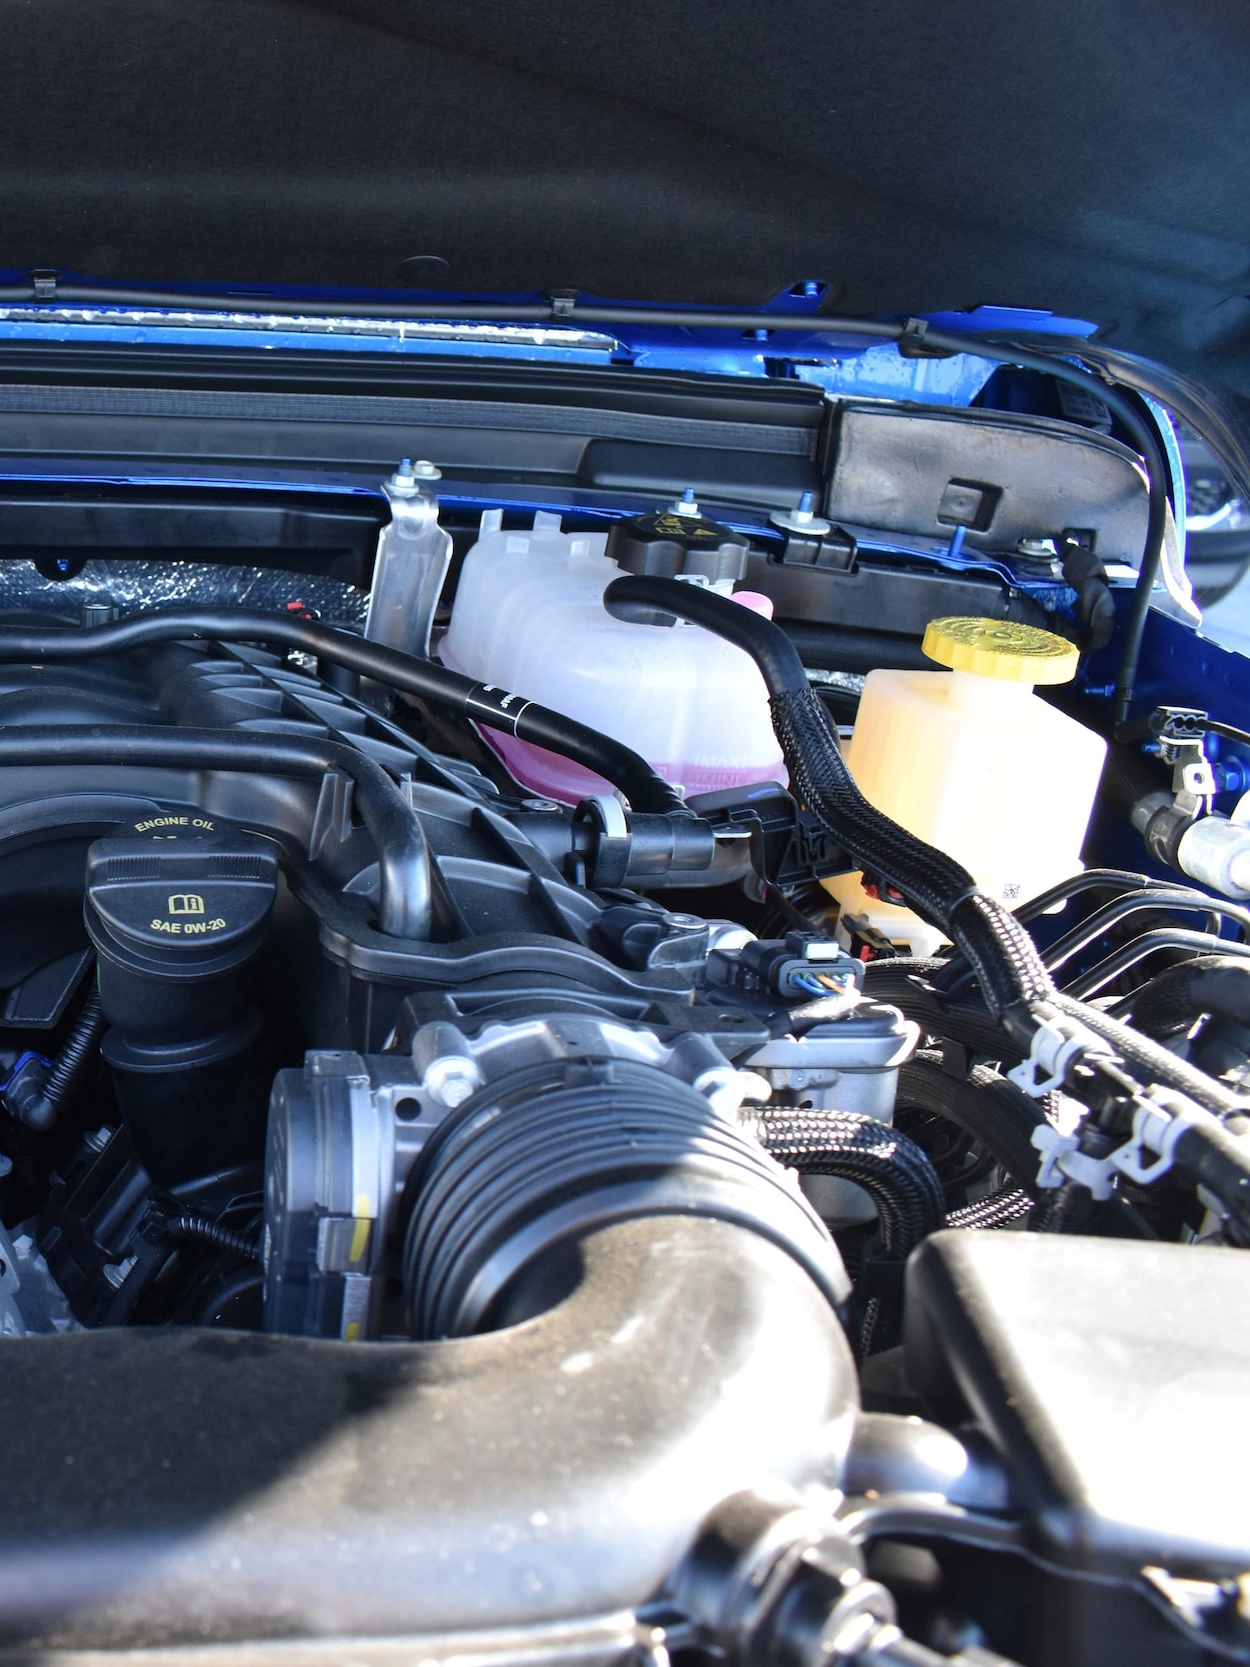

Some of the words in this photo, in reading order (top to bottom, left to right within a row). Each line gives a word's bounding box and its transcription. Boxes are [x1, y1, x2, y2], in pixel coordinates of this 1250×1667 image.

[134, 816, 189, 832] ENGINE
[192, 818, 215, 831] OIL
[150, 919, 181, 934] SAE
[184, 918, 226, 934] 0W-20
